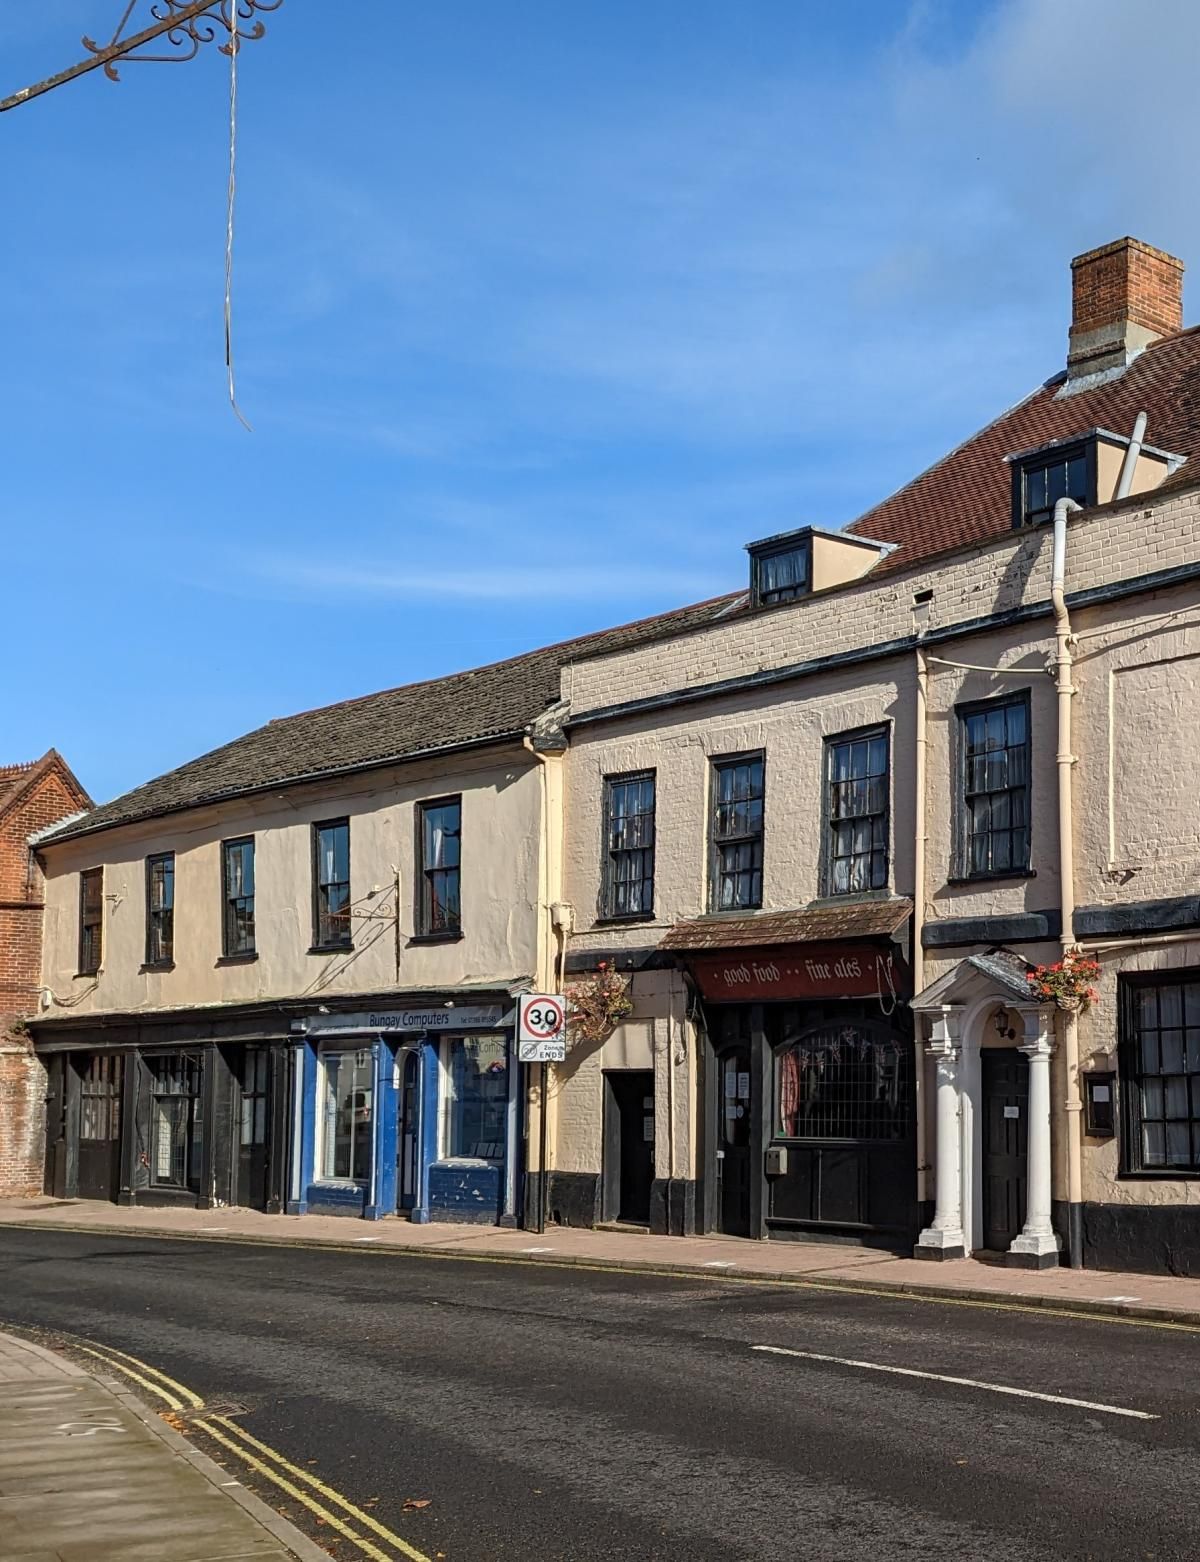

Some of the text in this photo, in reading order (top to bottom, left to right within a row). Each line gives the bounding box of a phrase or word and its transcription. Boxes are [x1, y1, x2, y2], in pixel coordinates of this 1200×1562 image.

[723, 957, 862, 987] good food fine ales
[369, 1013, 401, 1030] Bungay
[402, 1011, 450, 1028] Computers
[530, 1009, 557, 1026] 30
[539, 1051, 563, 1059] ENDS
